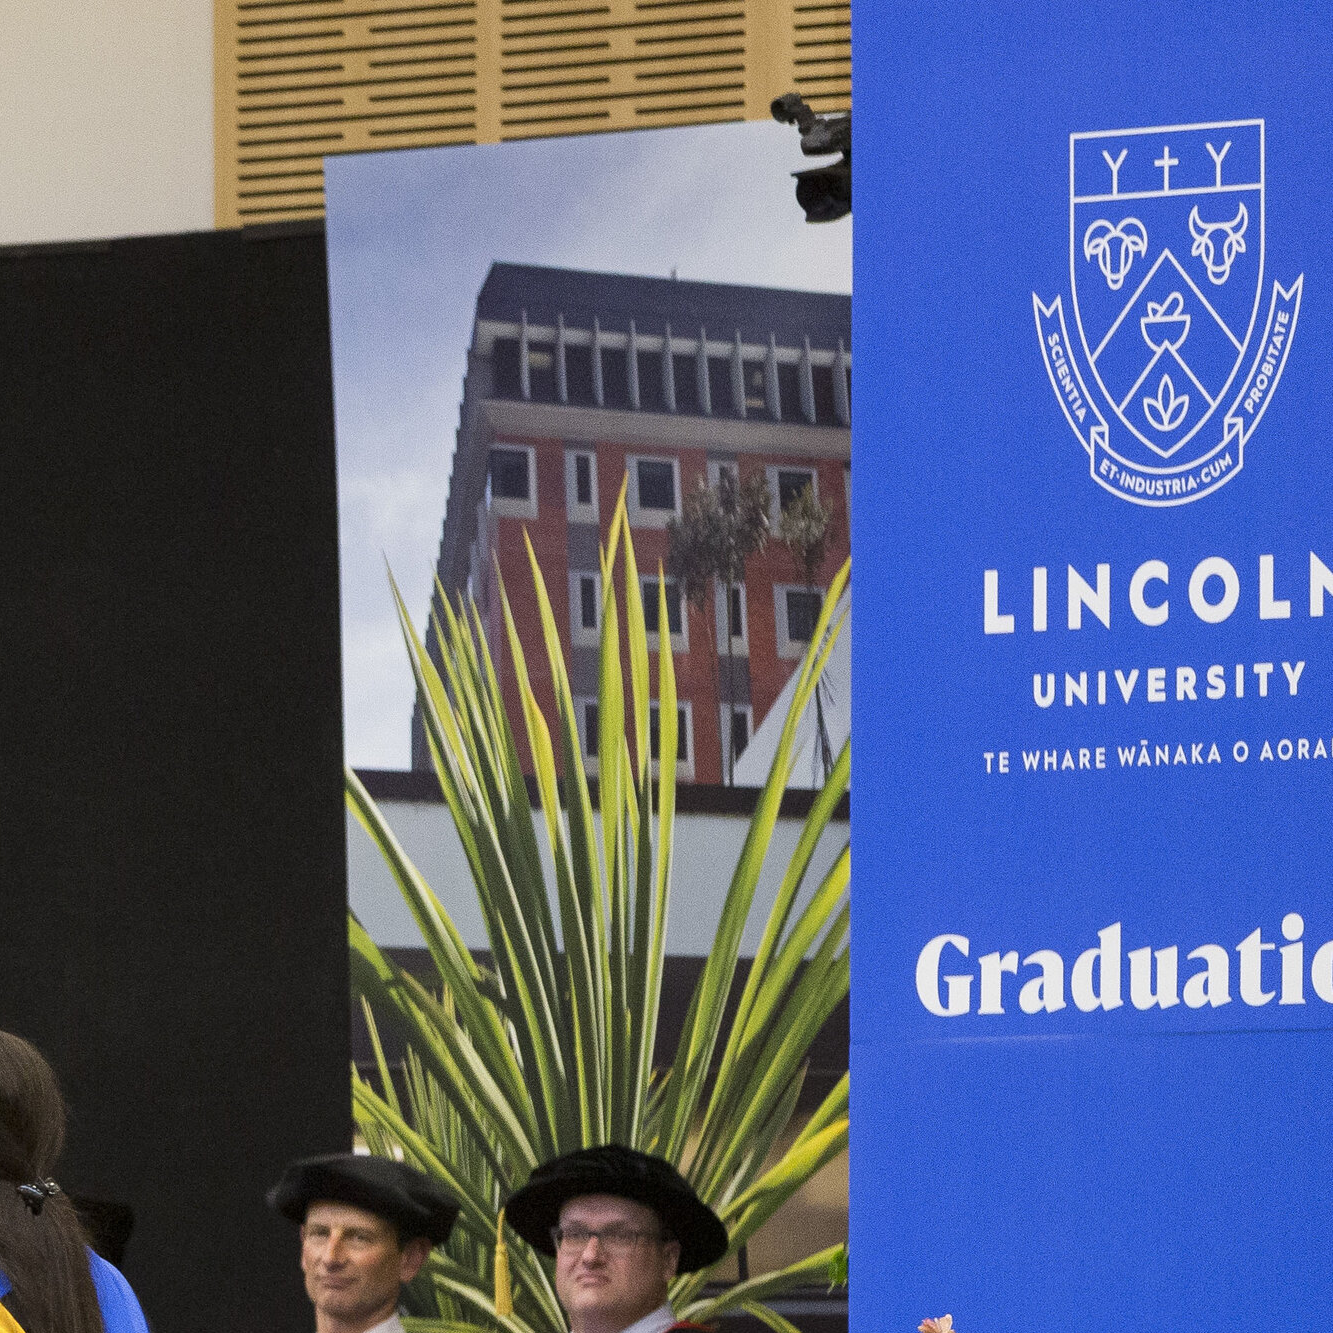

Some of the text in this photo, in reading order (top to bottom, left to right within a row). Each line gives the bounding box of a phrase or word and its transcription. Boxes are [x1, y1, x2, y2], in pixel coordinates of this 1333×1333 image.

[1046, 332, 1087, 423] SCIENTIA
[1244, 309, 1291, 414] PROBITATE
[1033, 661, 1306, 708] UNIVERSITY
[983, 737, 1333, 774] TE WHARE WĀNAKA O AORA
